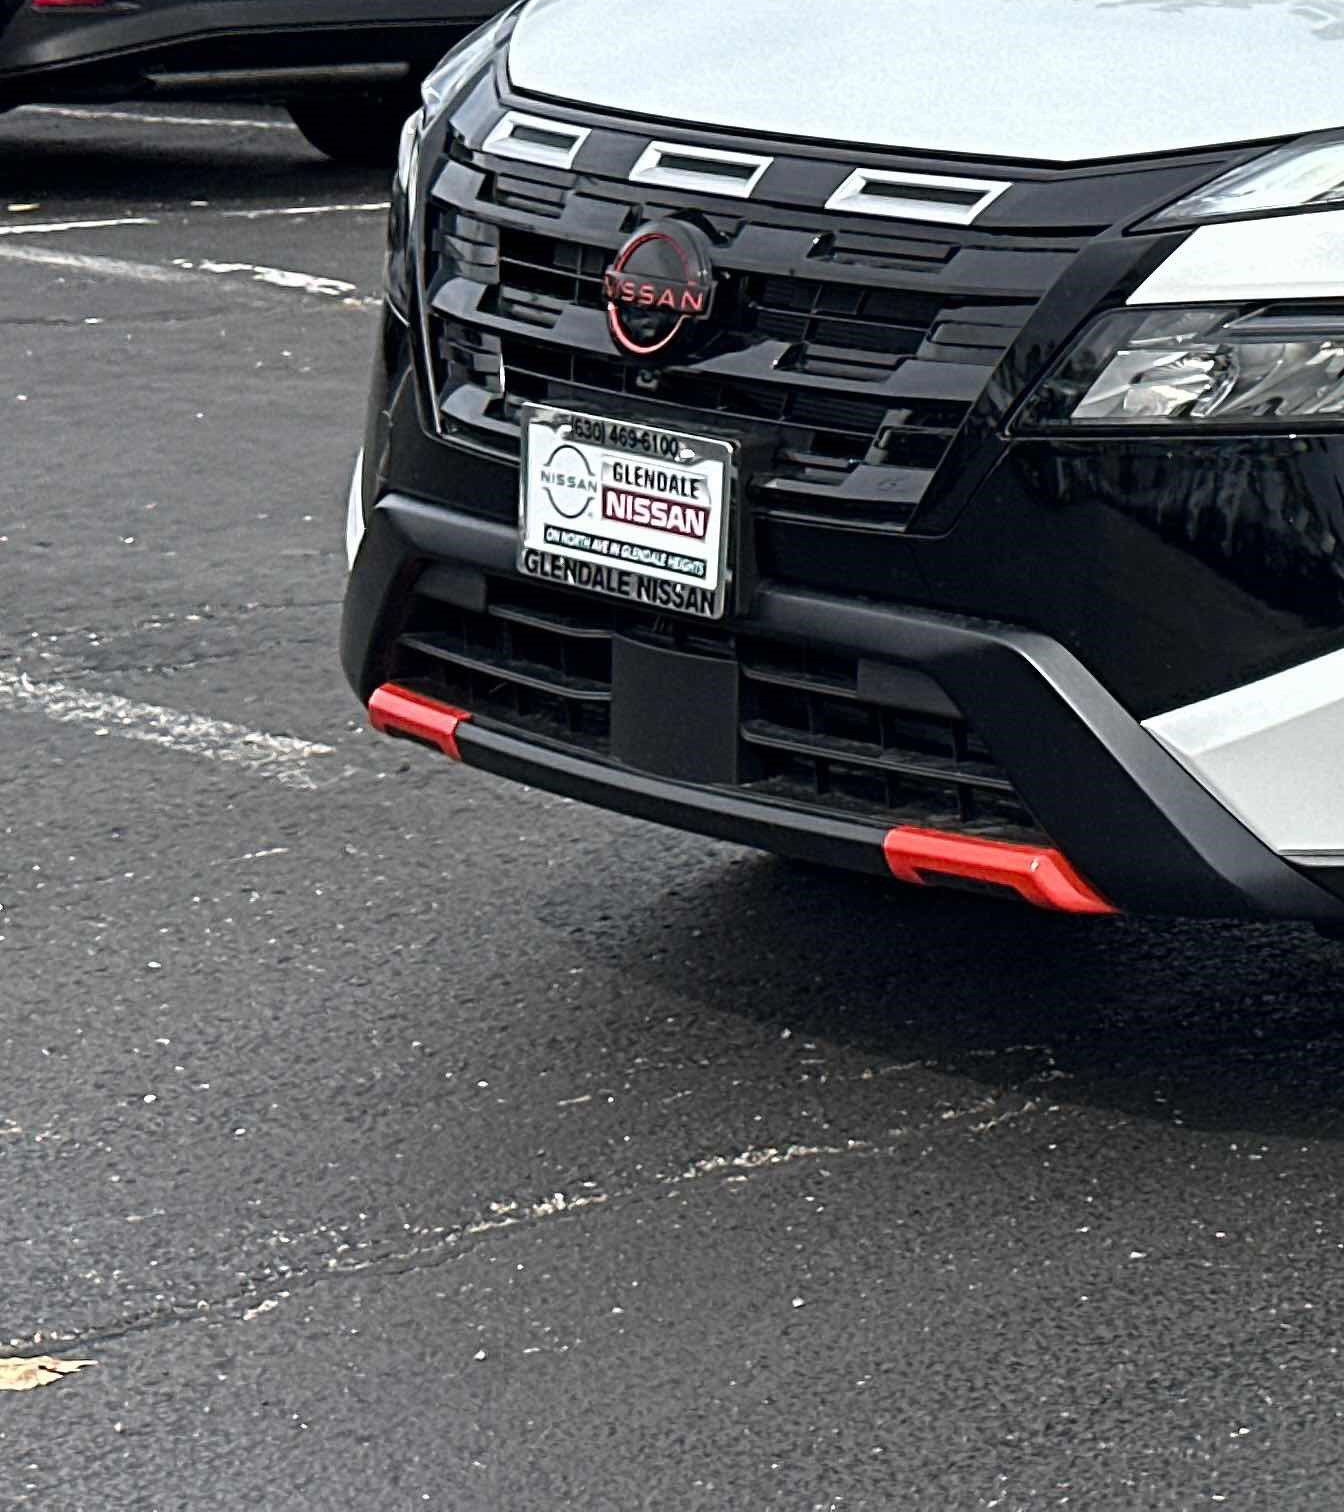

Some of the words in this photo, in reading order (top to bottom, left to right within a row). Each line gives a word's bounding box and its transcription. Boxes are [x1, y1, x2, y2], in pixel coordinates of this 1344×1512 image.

[540, 469, 598, 493] NISSAN
[612, 461, 701, 499] GLENDALE
[606, 490, 705, 536] NISSAN
[524, 547, 631, 595] GLENDALE
[636, 578, 716, 617] NISSAN
